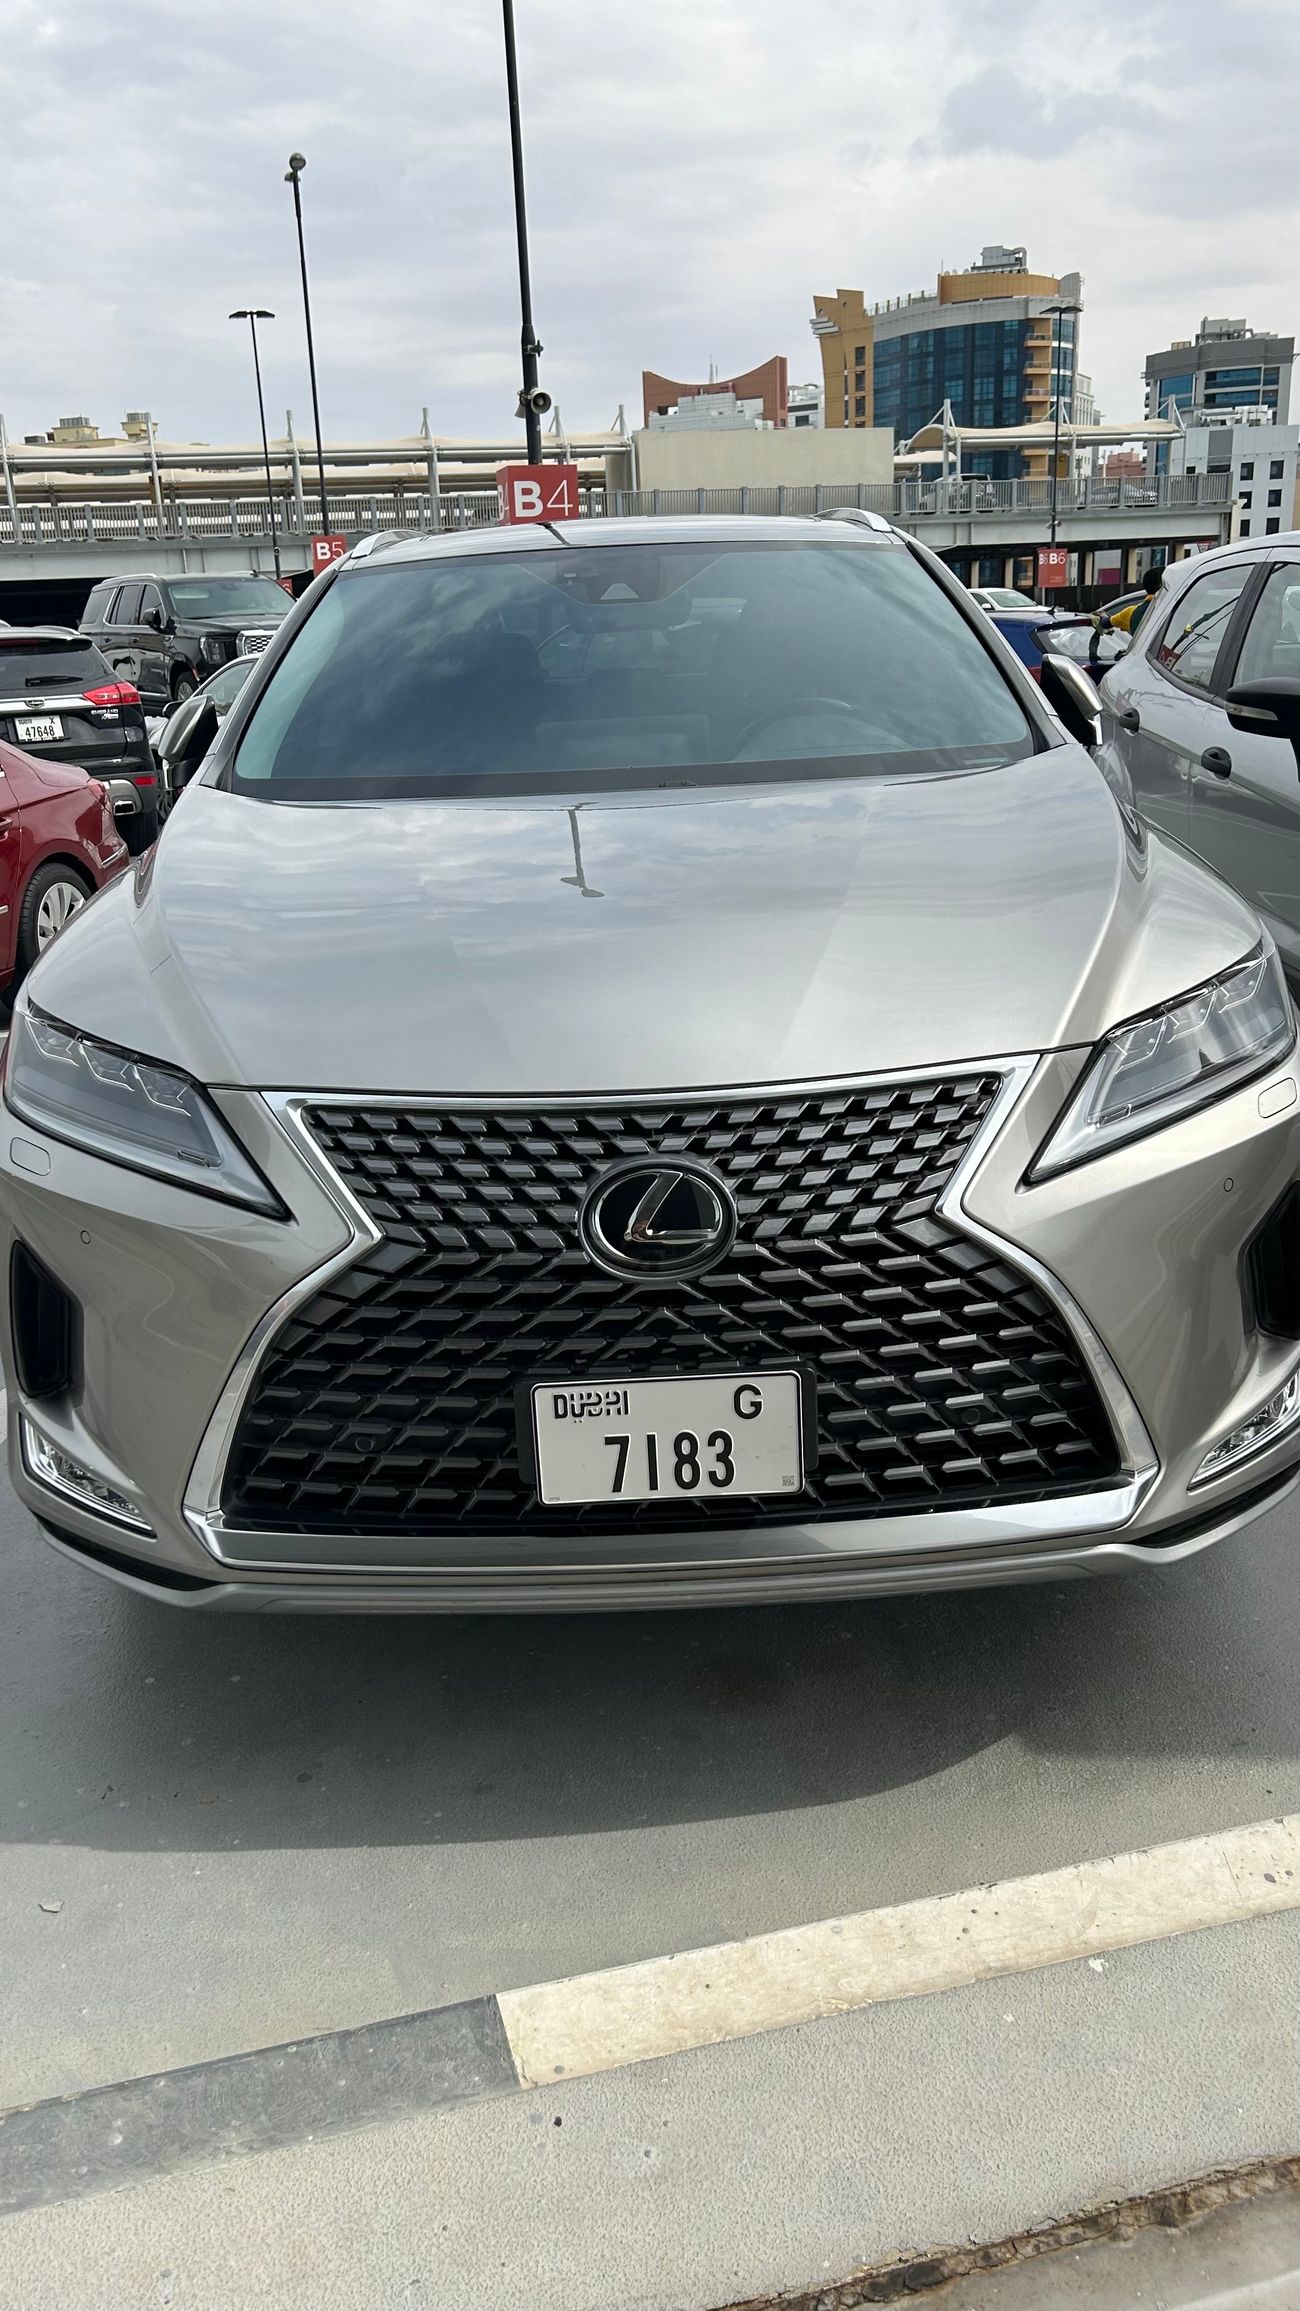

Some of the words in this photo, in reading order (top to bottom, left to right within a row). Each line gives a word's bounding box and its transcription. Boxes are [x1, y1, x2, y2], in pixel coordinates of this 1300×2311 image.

[513, 480, 574, 518] B4
[316, 541, 344, 560] B5
[1049, 552, 1066, 565] B6
[49, 717, 55, 725] X
[25, 725, 55, 738] 47648
[733, 1383, 763, 1419] G
[604, 1429, 735, 1494] 7183
